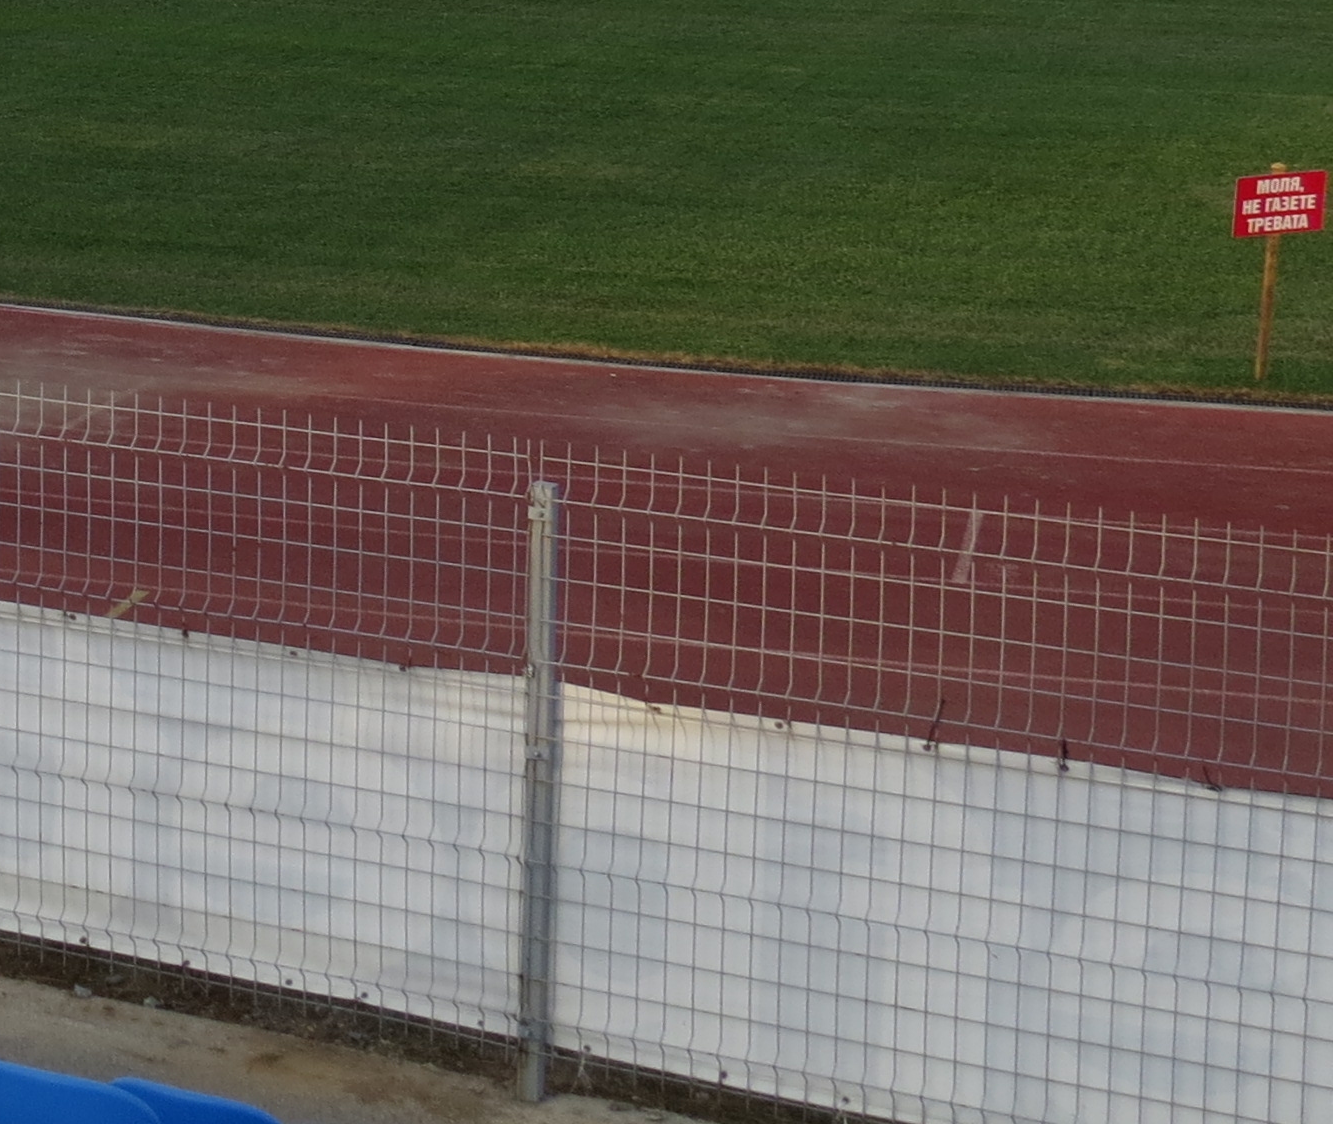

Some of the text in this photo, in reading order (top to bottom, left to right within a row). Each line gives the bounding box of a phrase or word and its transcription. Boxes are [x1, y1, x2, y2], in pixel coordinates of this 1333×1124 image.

[1256, 176, 1304, 195] МОЛЯ,
[1241, 194, 1316, 215] НЕ ГАЗЕТЕ
[1247, 214, 1308, 234] ТРЕВАТА
